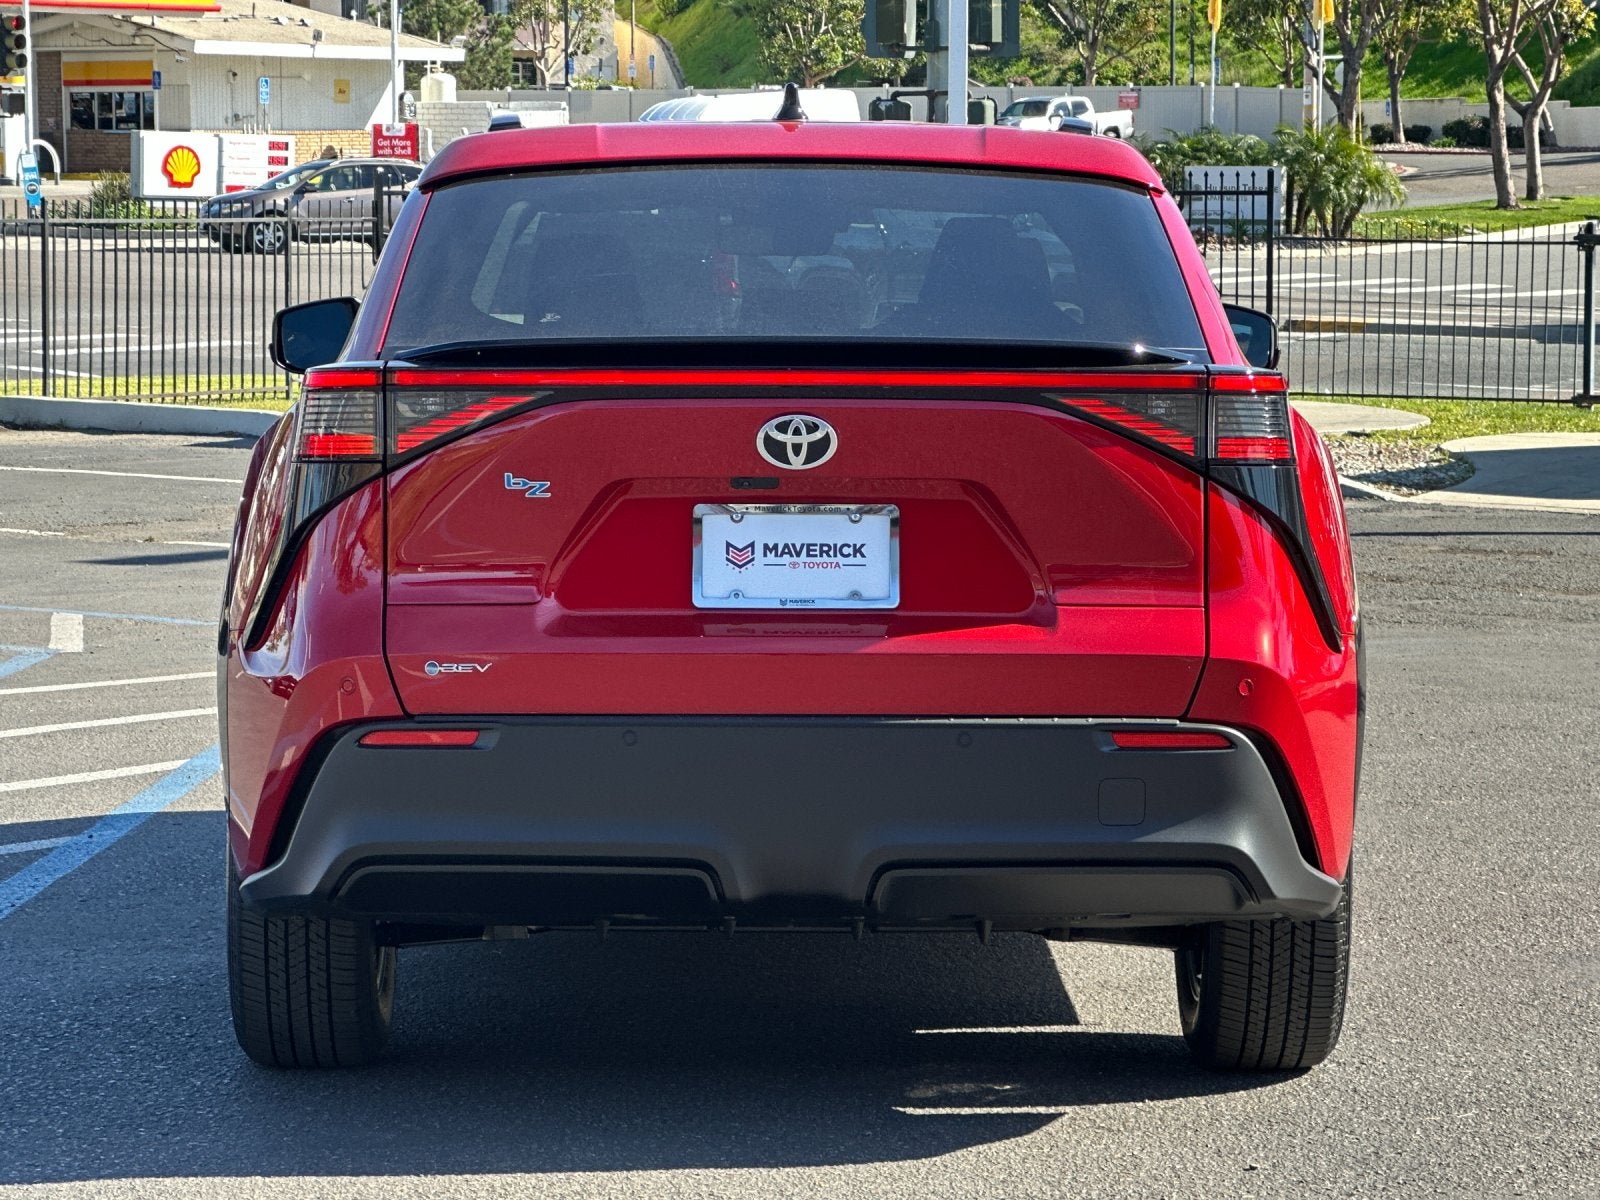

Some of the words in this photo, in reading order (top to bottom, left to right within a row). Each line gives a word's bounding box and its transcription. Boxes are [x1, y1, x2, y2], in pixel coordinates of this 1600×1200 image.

[377, 138, 390, 147] Get
[391, 138, 412, 147] More
[377, 147, 393, 155] with
[394, 147, 412, 155] Shell
[763, 543, 867, 558] MAVERICK
[440, 662, 493, 674] BEV
